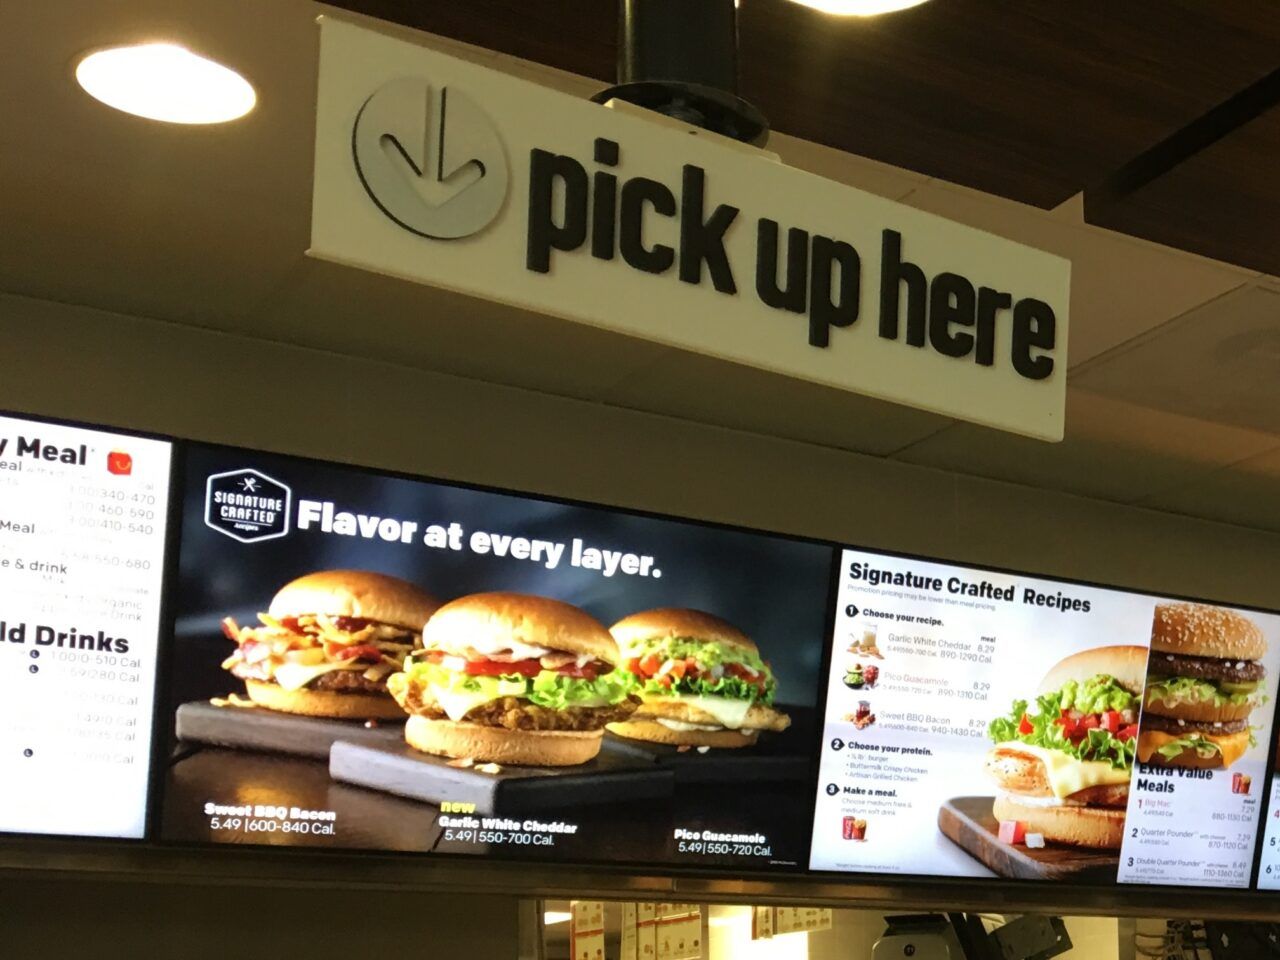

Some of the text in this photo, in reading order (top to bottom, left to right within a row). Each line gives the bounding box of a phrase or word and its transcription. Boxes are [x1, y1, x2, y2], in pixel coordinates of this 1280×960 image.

[527, 137, 1056, 380] pick up here
[16, 435, 87, 467] Meal
[214, 491, 282, 511] SIGNATURE
[220, 506, 274, 523] CRAFTED
[299, 499, 663, 578] Flavor at every layer.
[29, 560, 68, 575] drink
[849, 562, 1092, 613] Signature Crafted Recipes
[862, 608, 895, 620] Choose
[895, 614, 916, 624] your
[916, 616, 944, 627] recipe.
[34, 624, 130, 654] Drinks
[888, 632, 913, 644] Garlic
[914, 636, 937, 648] White
[938, 639, 972, 652] Cheddar
[880, 711, 905, 722] Sweet
[906, 714, 925, 724] BBQ
[926, 715, 951, 725] Bacon
[848, 741, 880, 752] Choose
[881, 745, 900, 755] your
[901, 746, 933, 757] protein.
[1177, 767, 1213, 780] Value
[843, 786, 867, 796] Make
[874, 788, 898, 798] meal.
[1136, 779, 1175, 794] Meals
[204, 802, 336, 821] Sweet BBQ Bacon
[440, 801, 476, 814] new
[311, 822, 336, 835] Cal.
[438, 815, 578, 834] Garlic White Cheddar
[532, 834, 555, 846] Cal.
[674, 828, 766, 844] Pico Guacamole
[1131, 827, 1138, 839] 2
[1270, 837, 1276, 846] 5
[753, 845, 772, 857] Cal.
[1127, 857, 1134, 868] 3
[1265, 864, 1272, 874] 6
